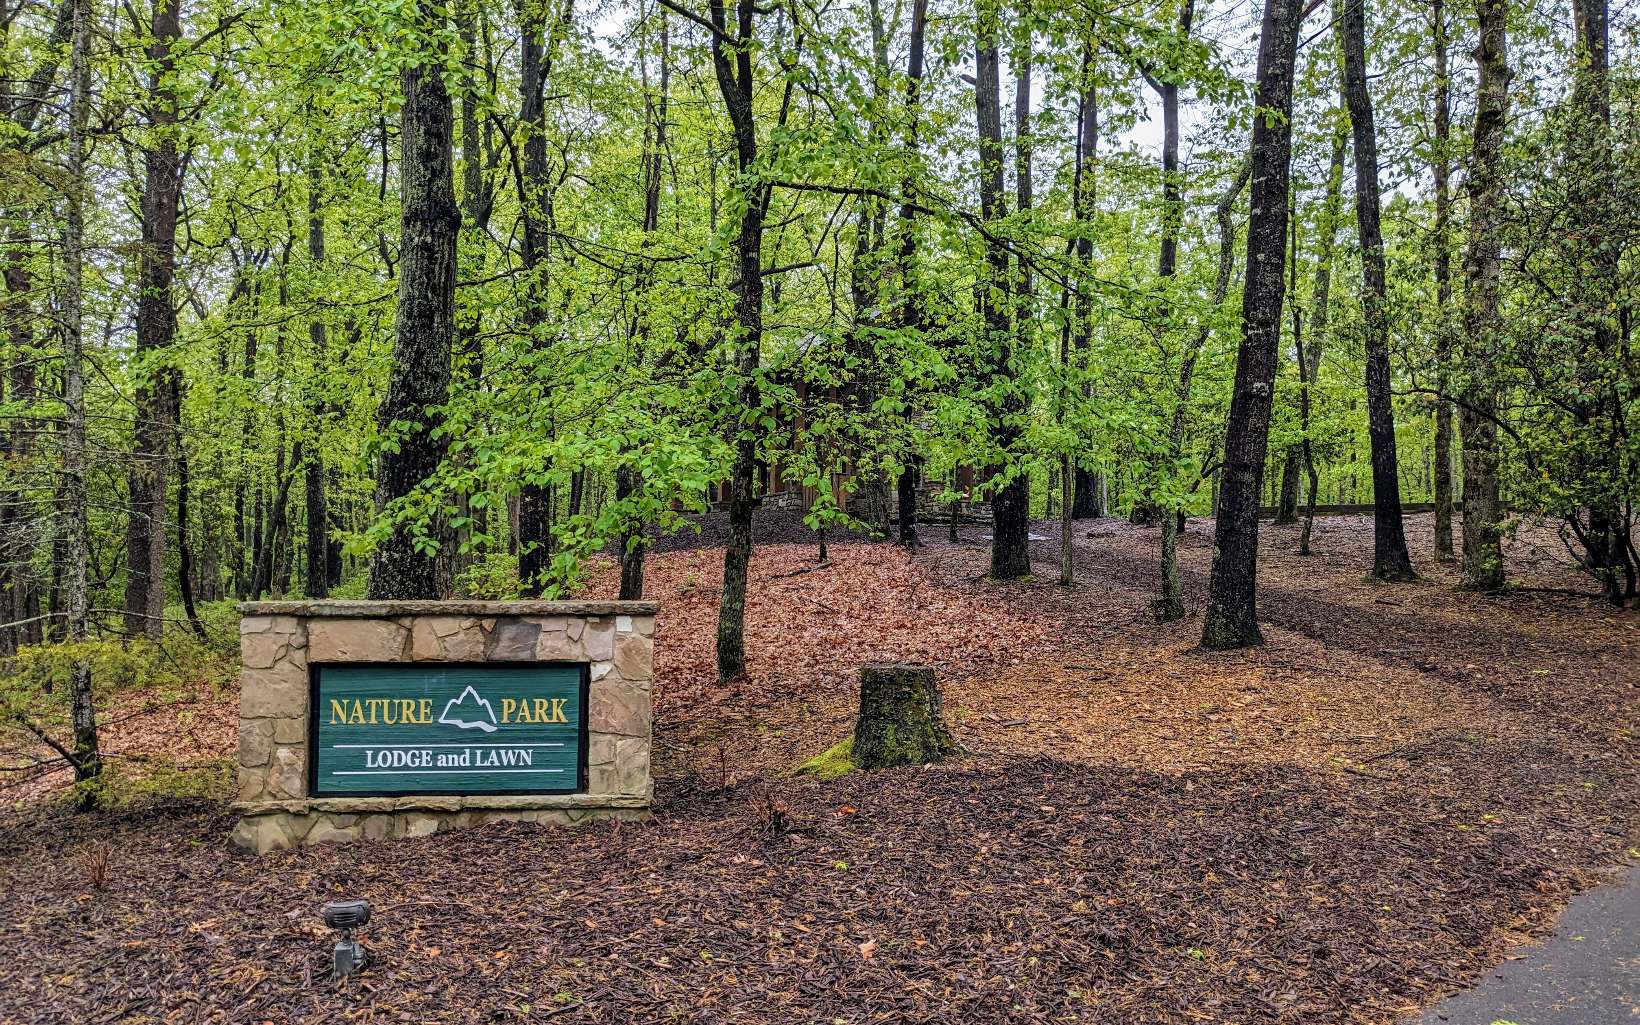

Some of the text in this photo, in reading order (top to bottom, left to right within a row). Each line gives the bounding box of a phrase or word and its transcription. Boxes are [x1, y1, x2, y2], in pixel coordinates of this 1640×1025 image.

[330, 698, 568, 725] NATURE PARK
[365, 749, 533, 768] LODGE and LAWN
